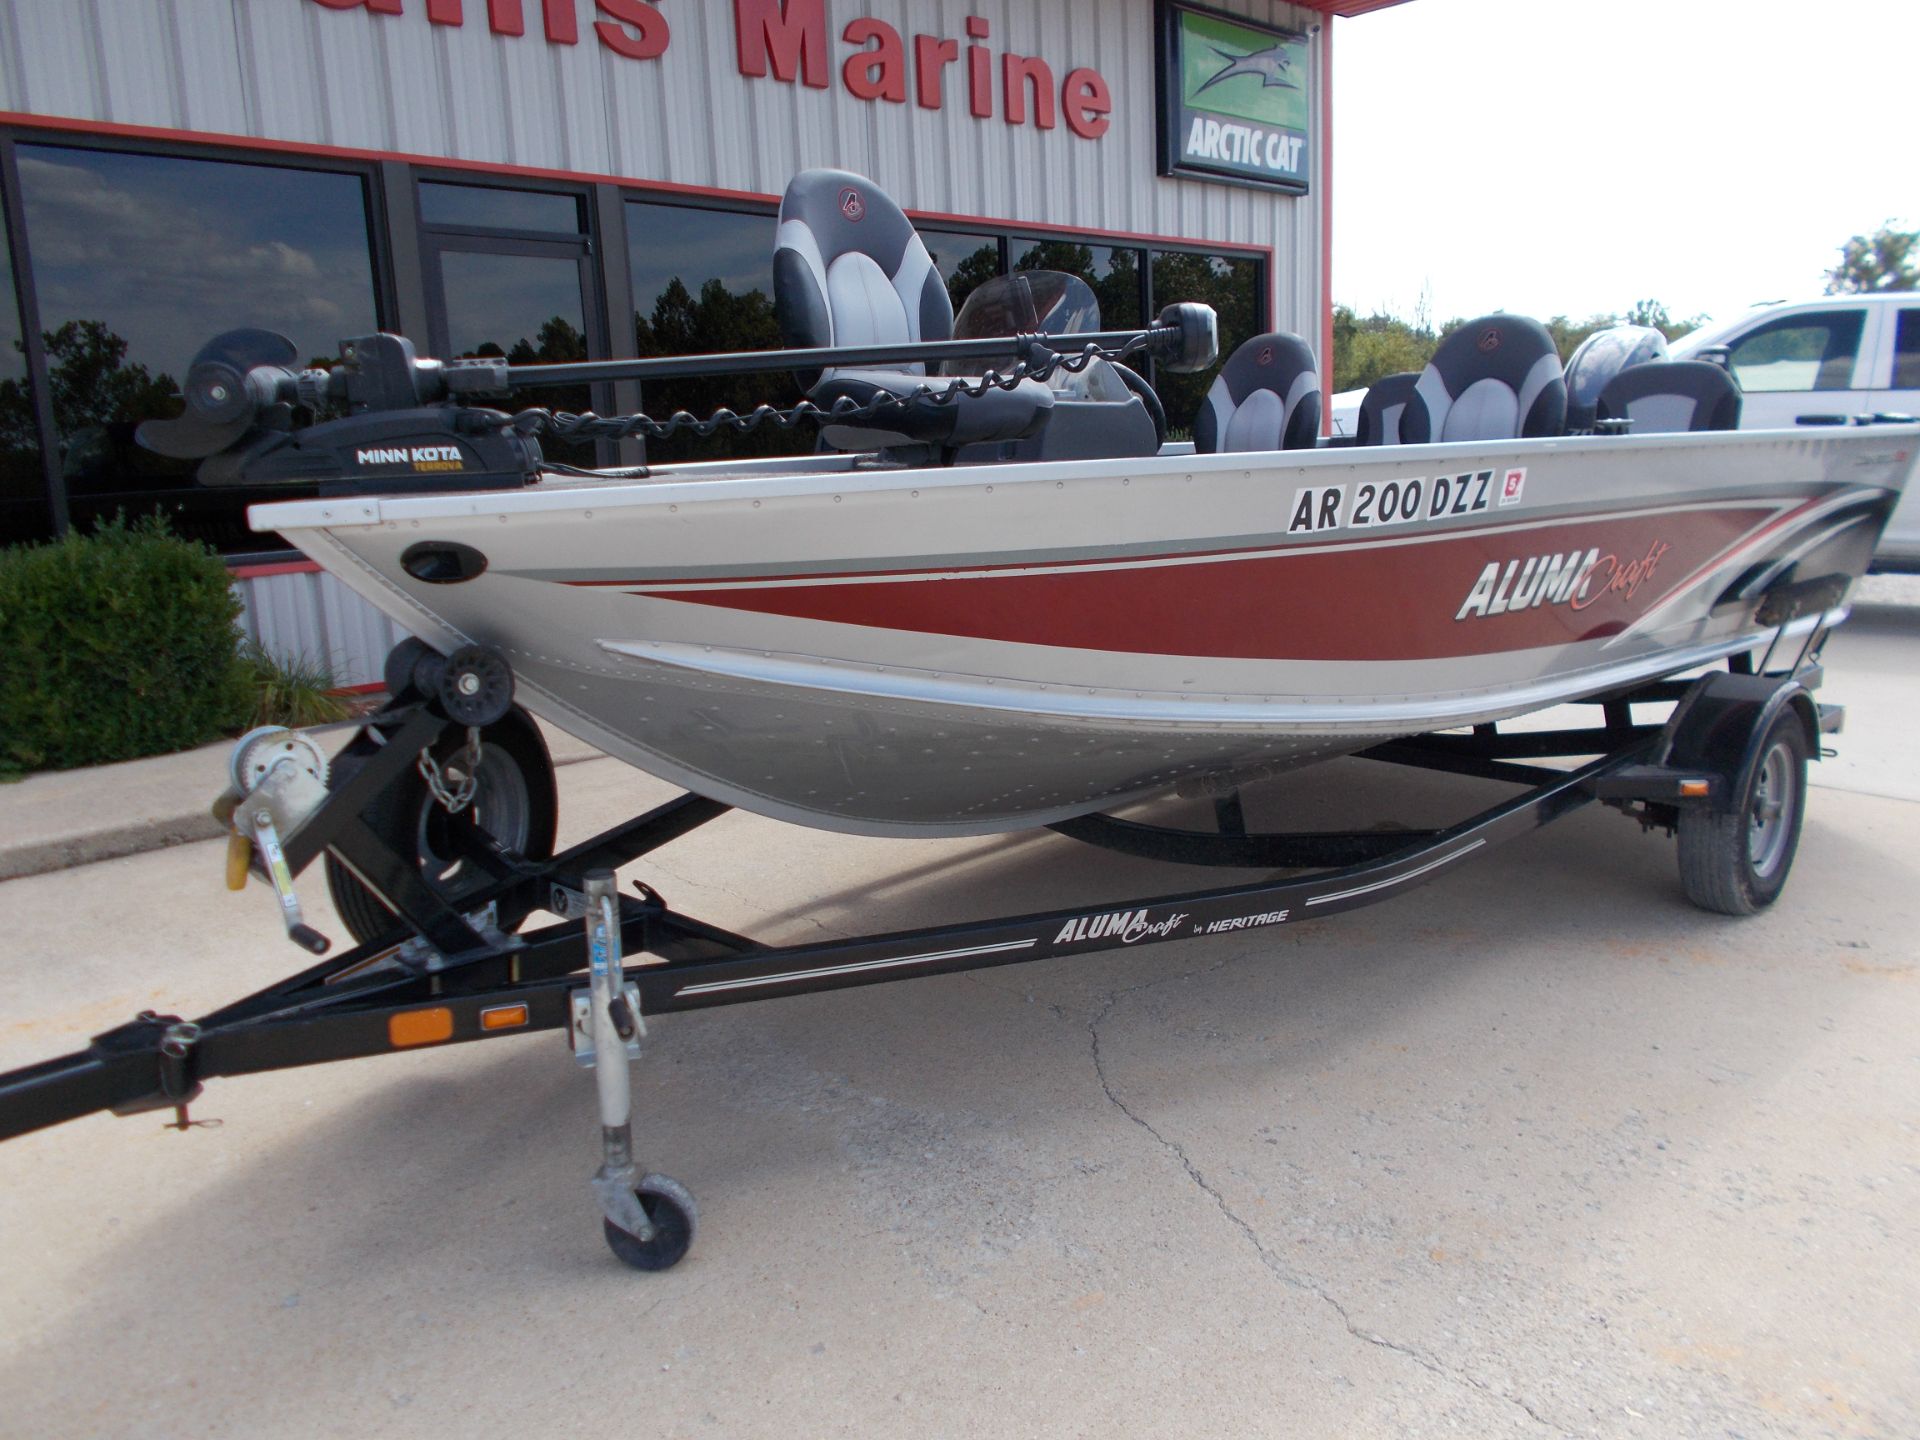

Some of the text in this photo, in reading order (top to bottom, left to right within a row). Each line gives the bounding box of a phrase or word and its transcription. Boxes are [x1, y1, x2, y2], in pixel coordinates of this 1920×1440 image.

[734, 0, 1112, 139] Marine
[1186, 117, 1303, 173] ARCTIC CAT
[357, 446, 463, 465] MINN KOTA
[1290, 470, 1494, 532] AR 200 DZZ
[1206, 909, 1290, 934] HERITAGE
